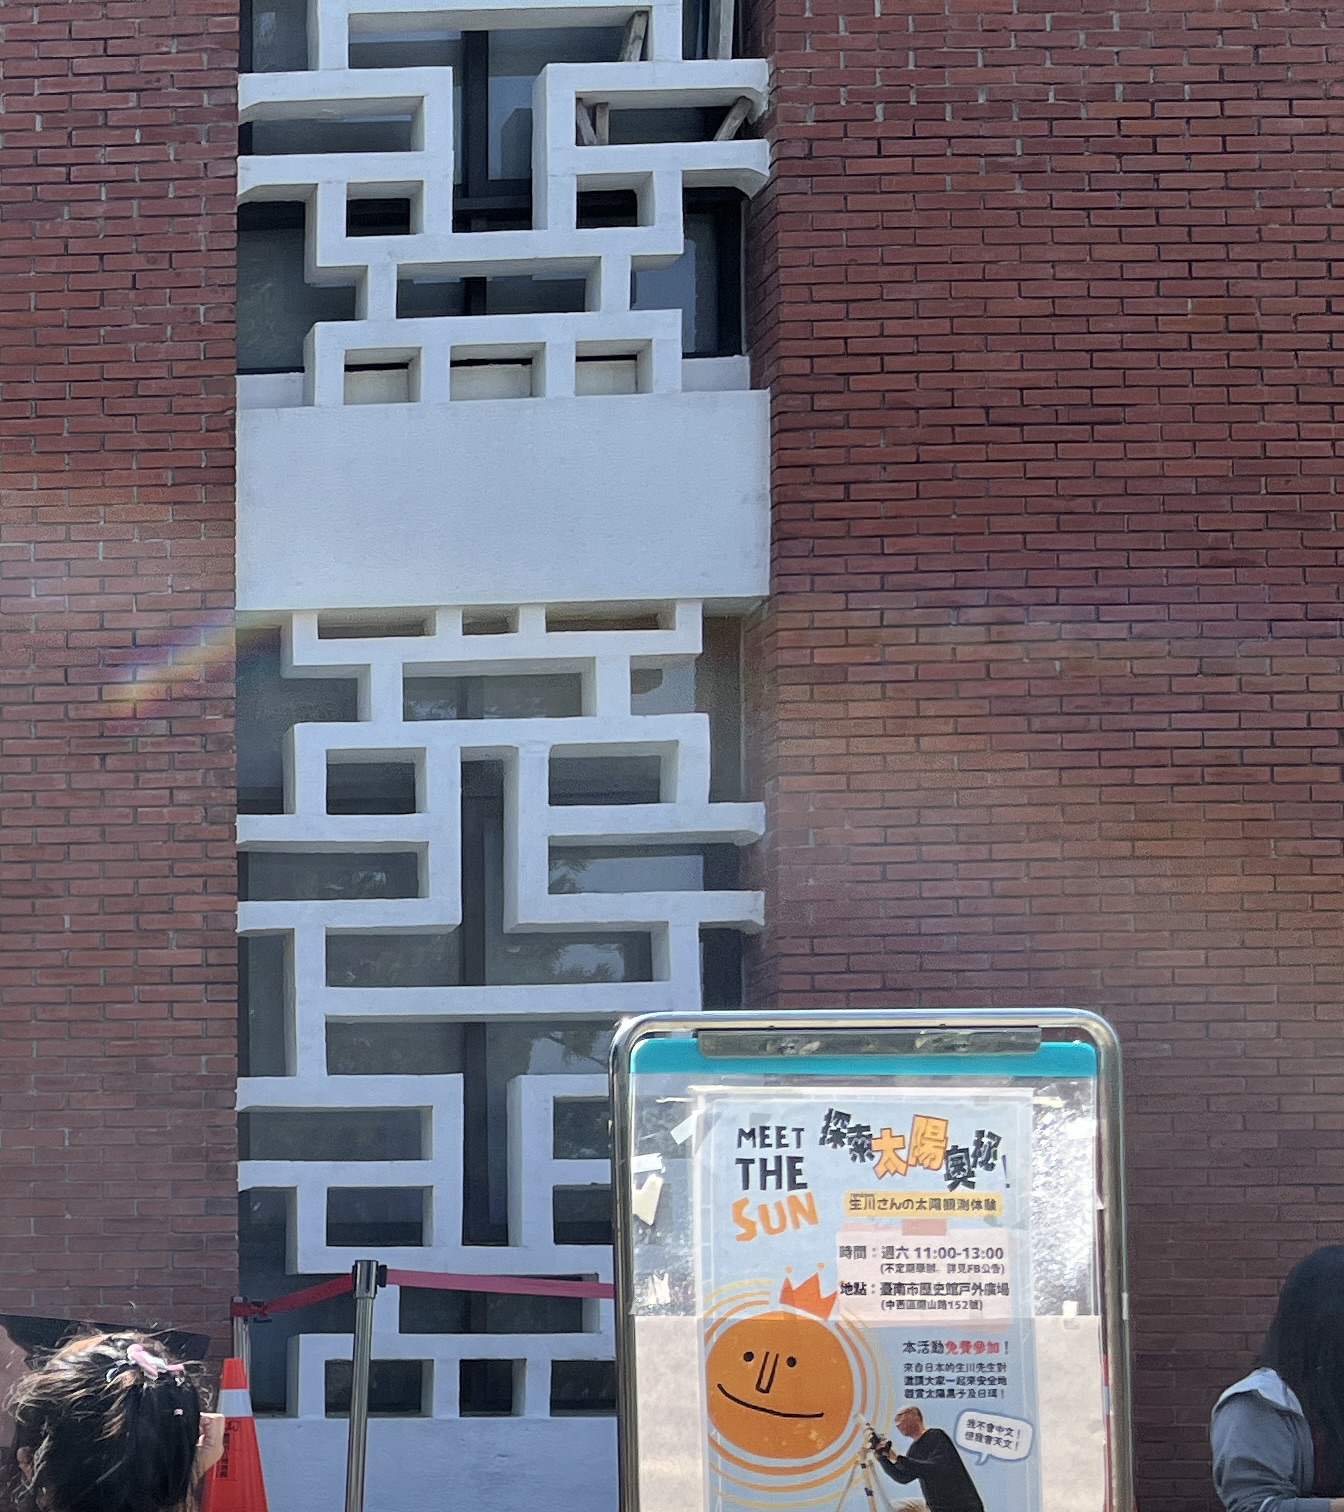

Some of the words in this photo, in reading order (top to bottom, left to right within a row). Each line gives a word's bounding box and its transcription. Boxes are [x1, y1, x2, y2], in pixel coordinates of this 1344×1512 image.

[737, 1126, 805, 1149] MEET
[735, 1155, 808, 1191] THE
[732, 1191, 819, 1242] SUN
[914, 1247, 1004, 1260] 11:00-13:00
